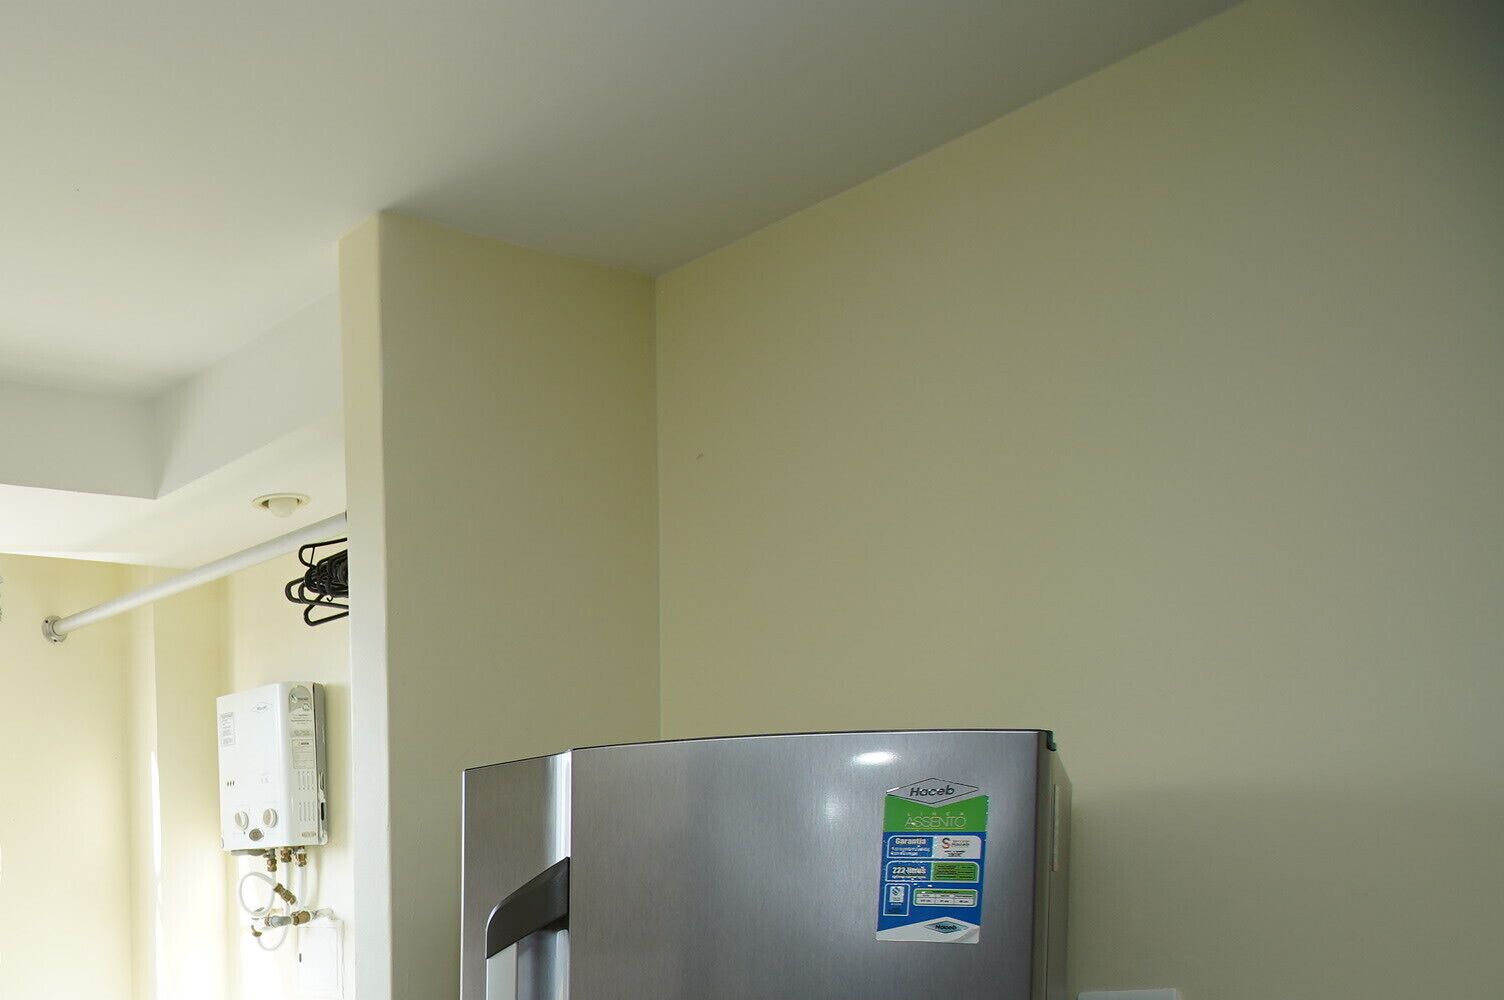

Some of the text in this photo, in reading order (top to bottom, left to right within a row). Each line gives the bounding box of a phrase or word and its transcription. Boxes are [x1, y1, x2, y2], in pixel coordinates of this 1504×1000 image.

[909, 785, 955, 797] Haceb
[904, 816, 967, 828] ASSENTO
[935, 924, 958, 932] Haceb
